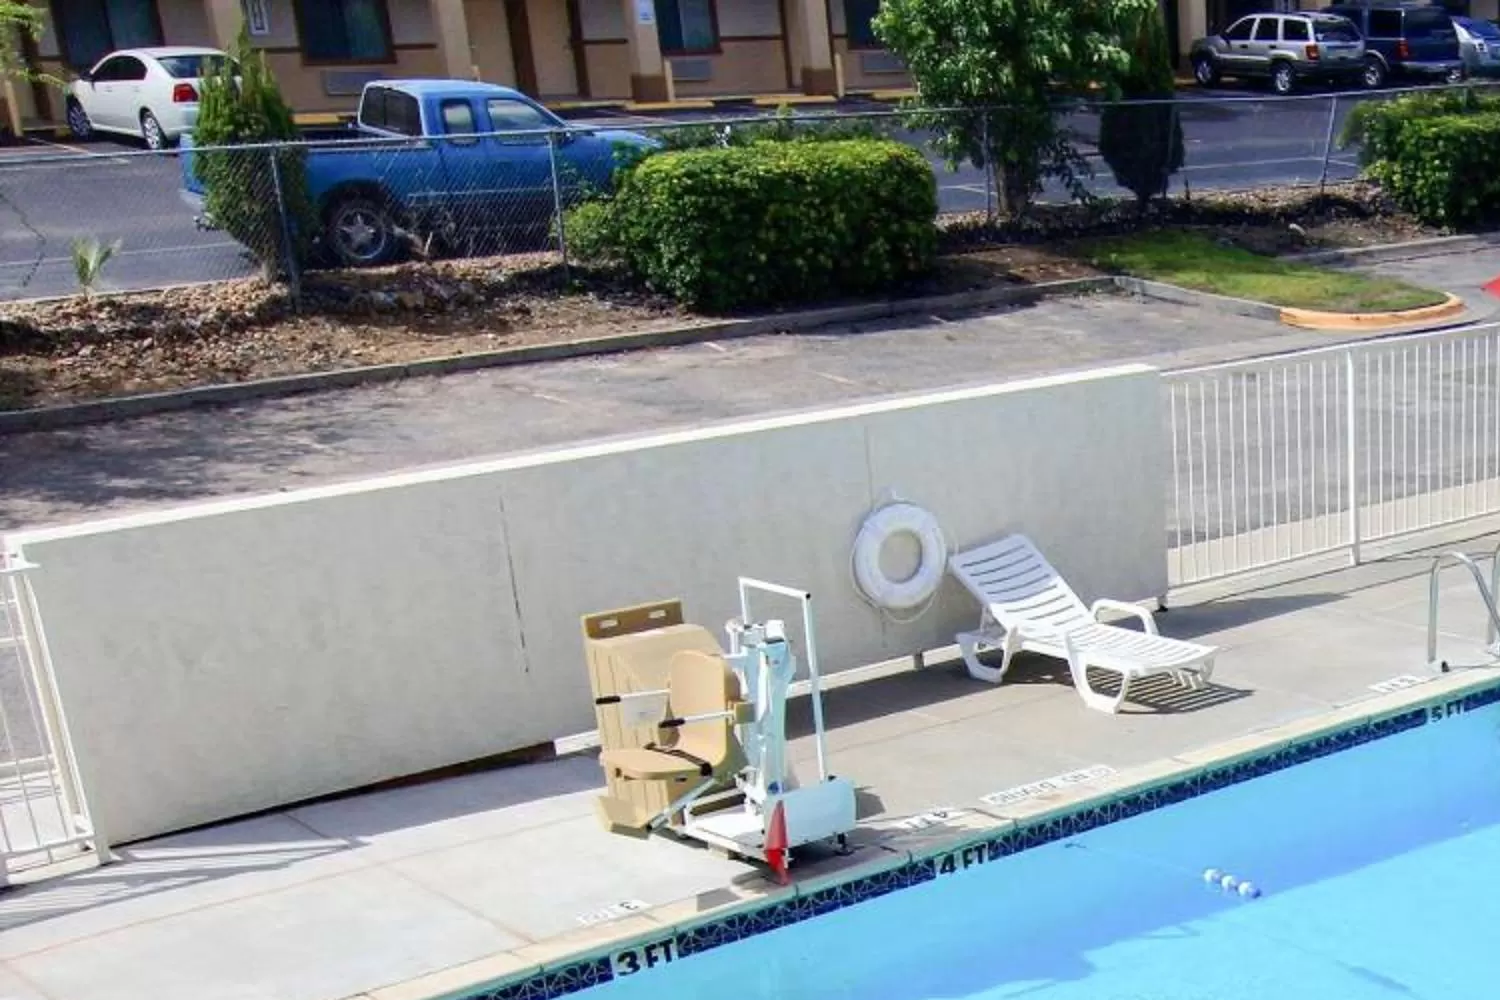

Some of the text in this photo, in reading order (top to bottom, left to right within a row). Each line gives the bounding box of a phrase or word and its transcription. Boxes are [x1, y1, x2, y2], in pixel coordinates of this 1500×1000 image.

[940, 853, 957, 875] 4
[616, 937, 675, 977] 3 FT
